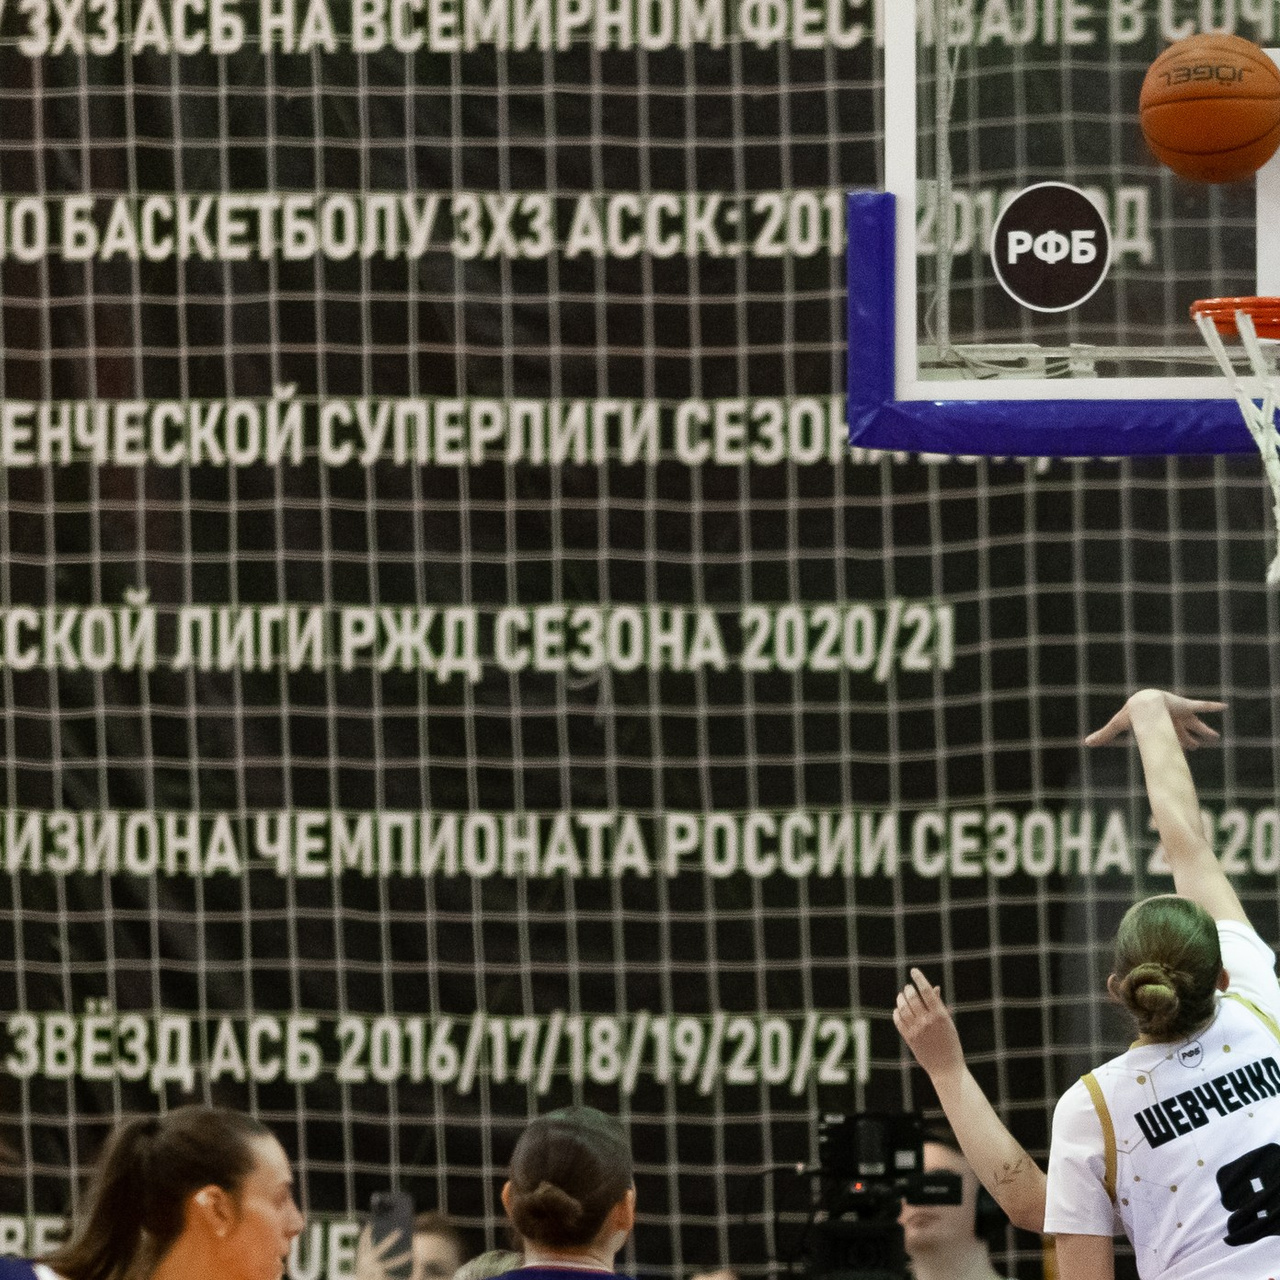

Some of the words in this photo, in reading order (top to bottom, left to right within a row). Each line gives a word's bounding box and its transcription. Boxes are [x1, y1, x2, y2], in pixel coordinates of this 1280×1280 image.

[131, 0, 246, 57] АСБ
[260, 0, 338, 55] НА
[352, 0, 724, 54] ВСЕМИРНОМ
[62, 193, 441, 261] БАСКЕТБОЛУ
[565, 192, 743, 258] АССК:
[1007, 230, 1097, 265] РФБ
[2, 383, 301, 467] ЕНЧЕСКОЙ
[318, 399, 660, 467] СУПЕРЛИГИ
[3, 588, 157, 673] СКОЙ
[172, 604, 327, 673] ЛИГИ
[341, 604, 483, 685] РЖД
[495, 603, 729, 673] СЕЗОНА
[740, 599, 956, 683] 2020/21
[4, 810, 243, 877] ИЗИОНА
[253, 810, 653, 878] ЧЕМПИОНАТА
[666, 811, 899, 878] РОССИИ
[911, 810, 1133, 878] СЕЗОНА
[6, 998, 196, 1093] ЗВЁЗД
[209, 1016, 321, 1082] АСБ
[335, 1010, 872, 1096] 2016/17/18/19/20/21
